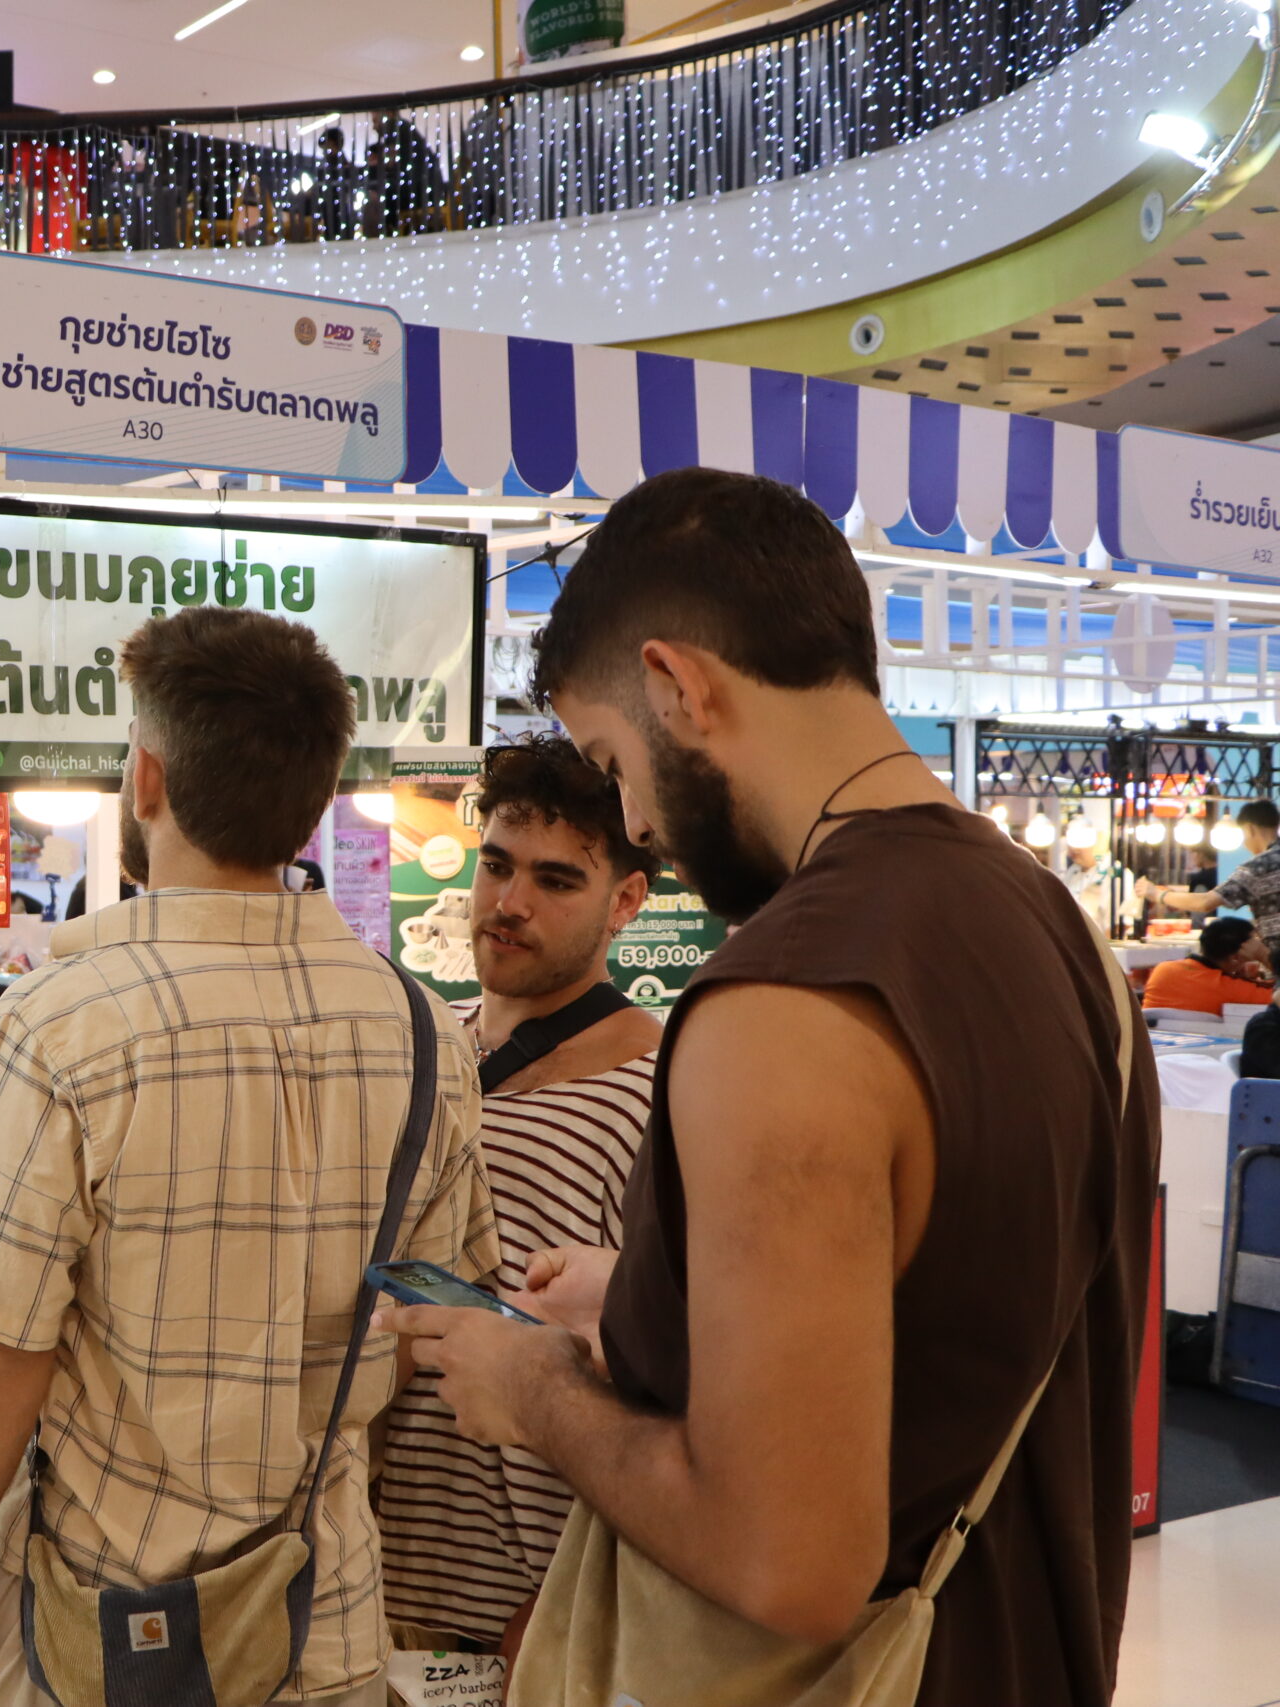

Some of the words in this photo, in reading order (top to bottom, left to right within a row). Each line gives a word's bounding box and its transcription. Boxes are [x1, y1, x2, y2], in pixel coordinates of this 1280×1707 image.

[58, 313, 232, 360] กุยช่ายไฮโซ
[324, 322, 354, 341] DBD
[122, 419, 164, 441] A30
[1252, 548, 1273, 564] A32
[1132, 1492, 1151, 1514] 07
